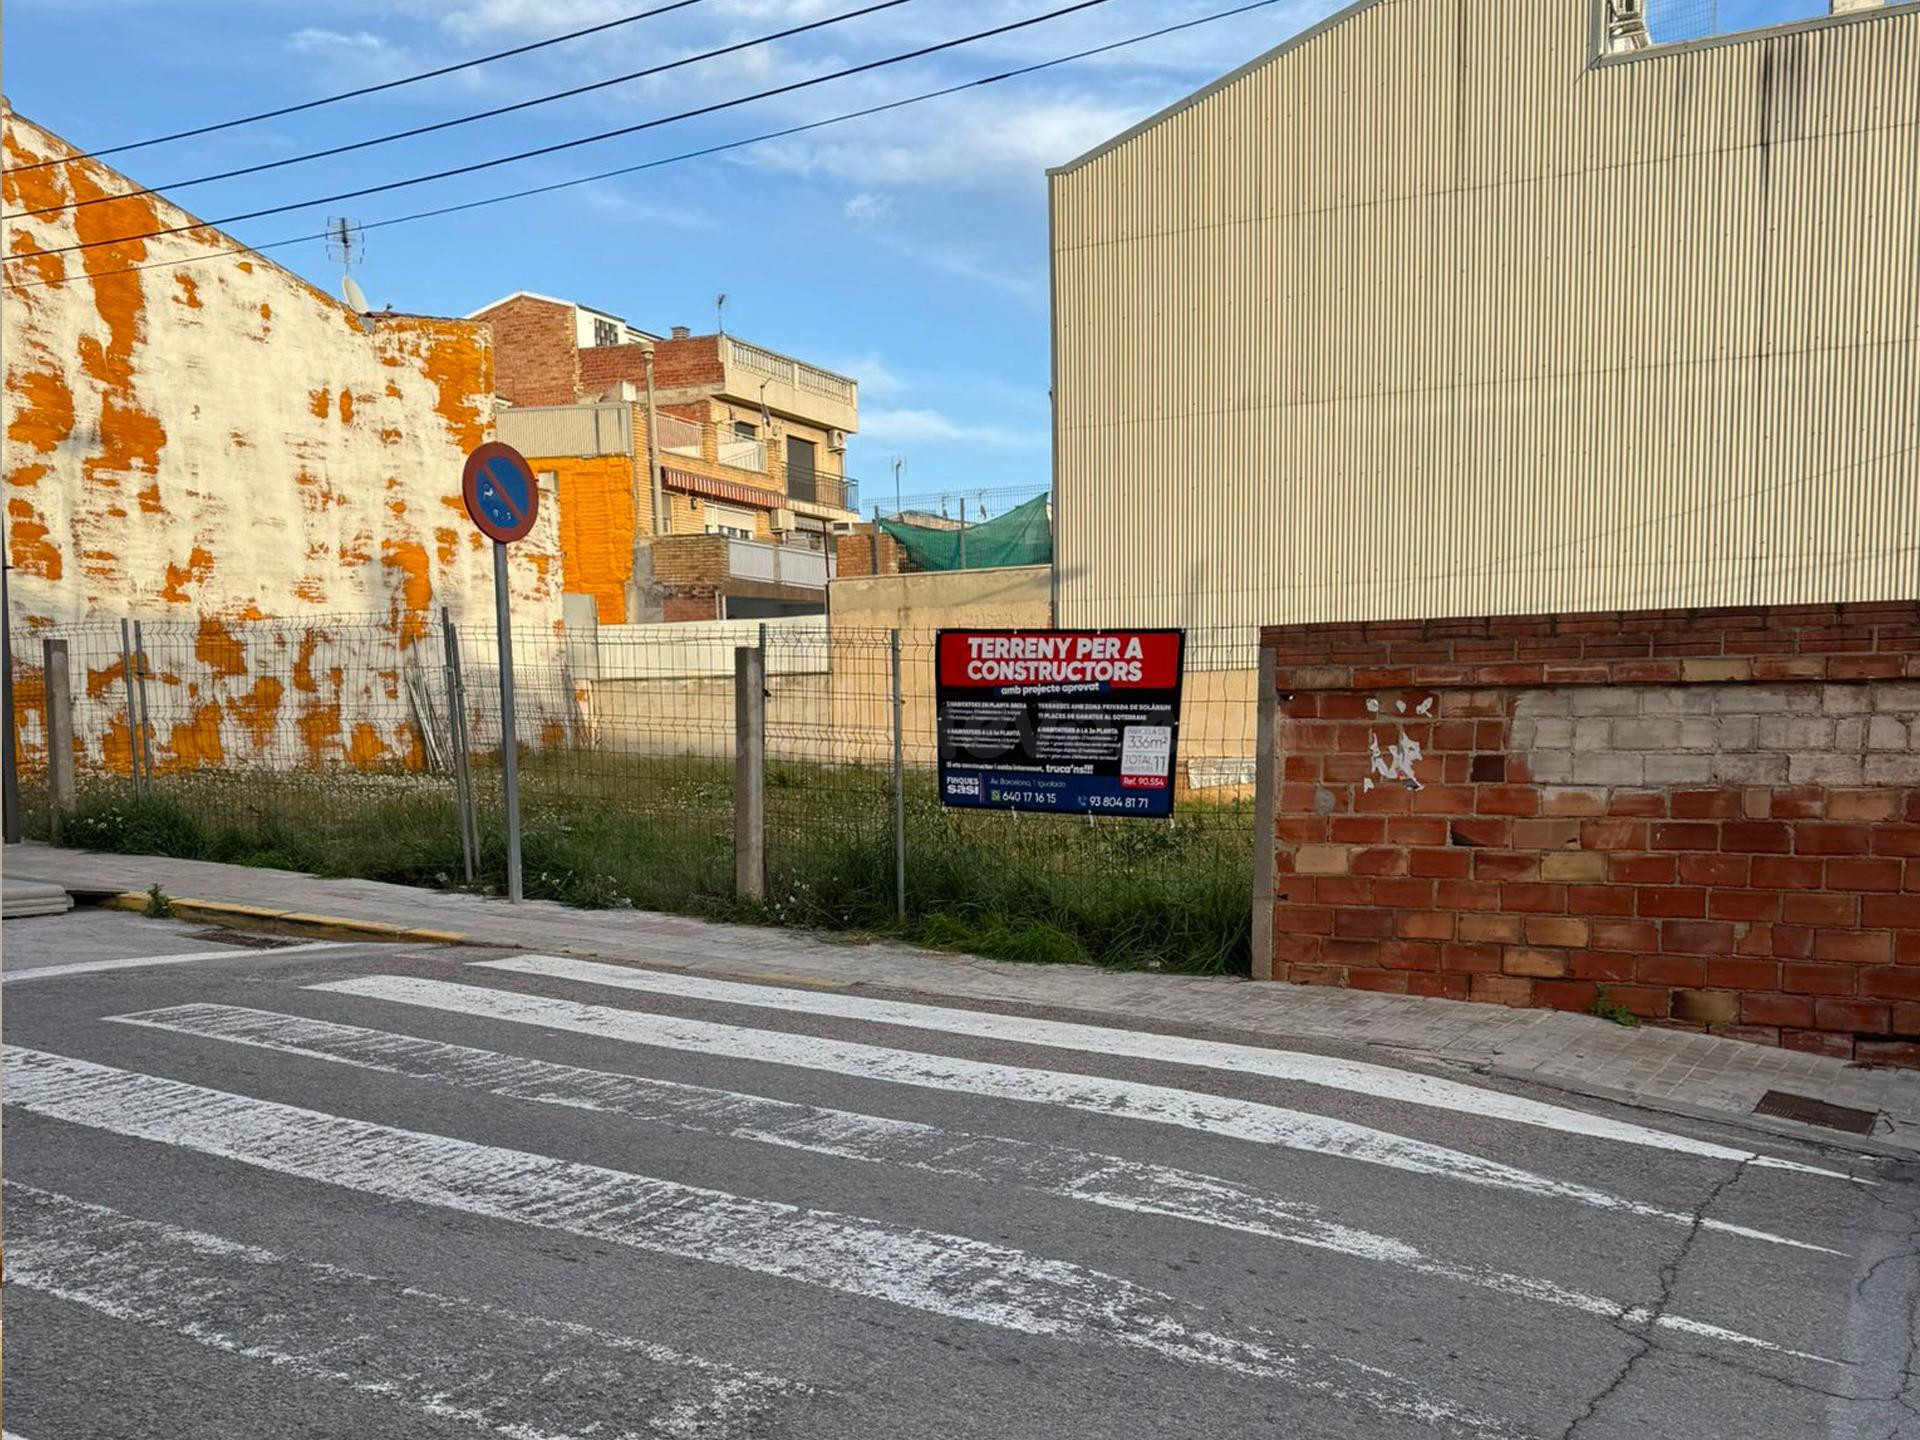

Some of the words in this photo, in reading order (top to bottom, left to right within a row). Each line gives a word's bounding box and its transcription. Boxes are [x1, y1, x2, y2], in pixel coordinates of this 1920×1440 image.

[967, 637, 1072, 659] TERRENY
[1076, 637, 1121, 660] PER
[1123, 637, 1143, 660] A
[967, 660, 1143, 682] CONSTRUCTORS
[1000, 685, 1021, 695] amb
[1022, 683, 1061, 696] projecte
[1061, 682, 1100, 694] aprovat
[1125, 753, 1153, 766] TOTAL
[1153, 754, 1166, 774] 11
[946, 776, 980, 785] FINQUES
[1123, 776, 1138, 785] Ref.
[1138, 776, 1165, 787] 90.554
[1002, 790, 1022, 803] 640
[1023, 791, 1034, 803] 17
[1035, 792, 1045, 804] 16
[1046, 792, 1057, 804] 15
[1089, 796, 1101, 807] 93
[1102, 796, 1123, 808] 804
[1124, 796, 1136, 808] 81
[1137, 797, 1150, 809] 71
